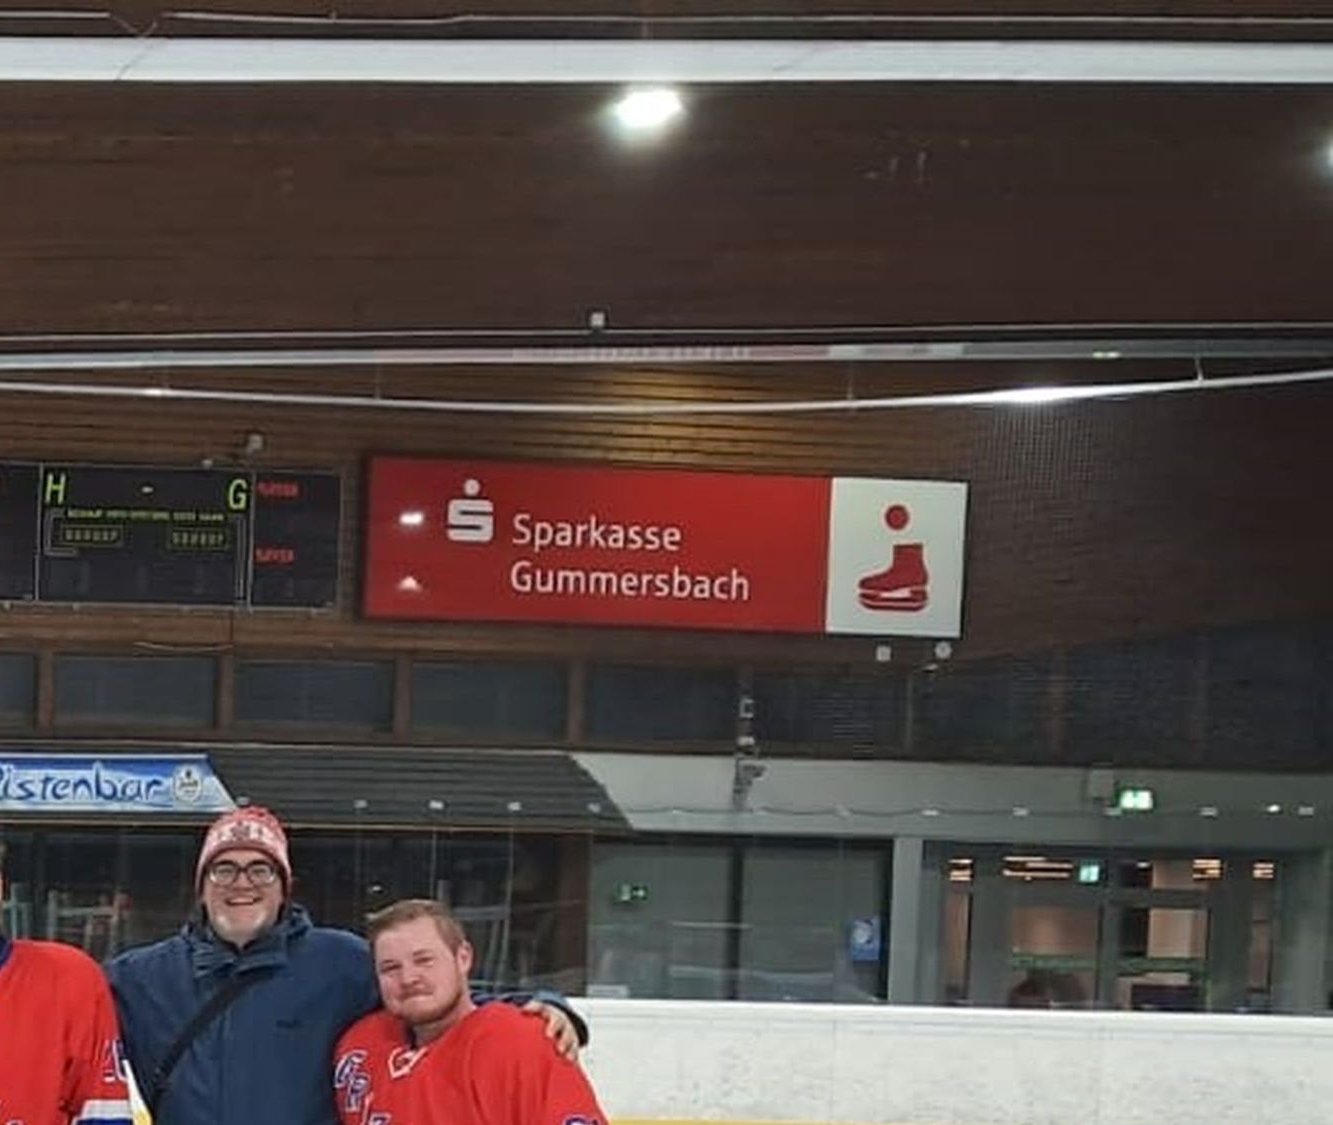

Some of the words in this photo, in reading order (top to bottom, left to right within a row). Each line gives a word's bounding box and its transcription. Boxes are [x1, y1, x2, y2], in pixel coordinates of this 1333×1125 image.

[44, 473, 66, 504] H
[228, 479, 248, 509] G
[511, 513, 683, 553] Sparkasse
[510, 560, 750, 602] Gummersbach
